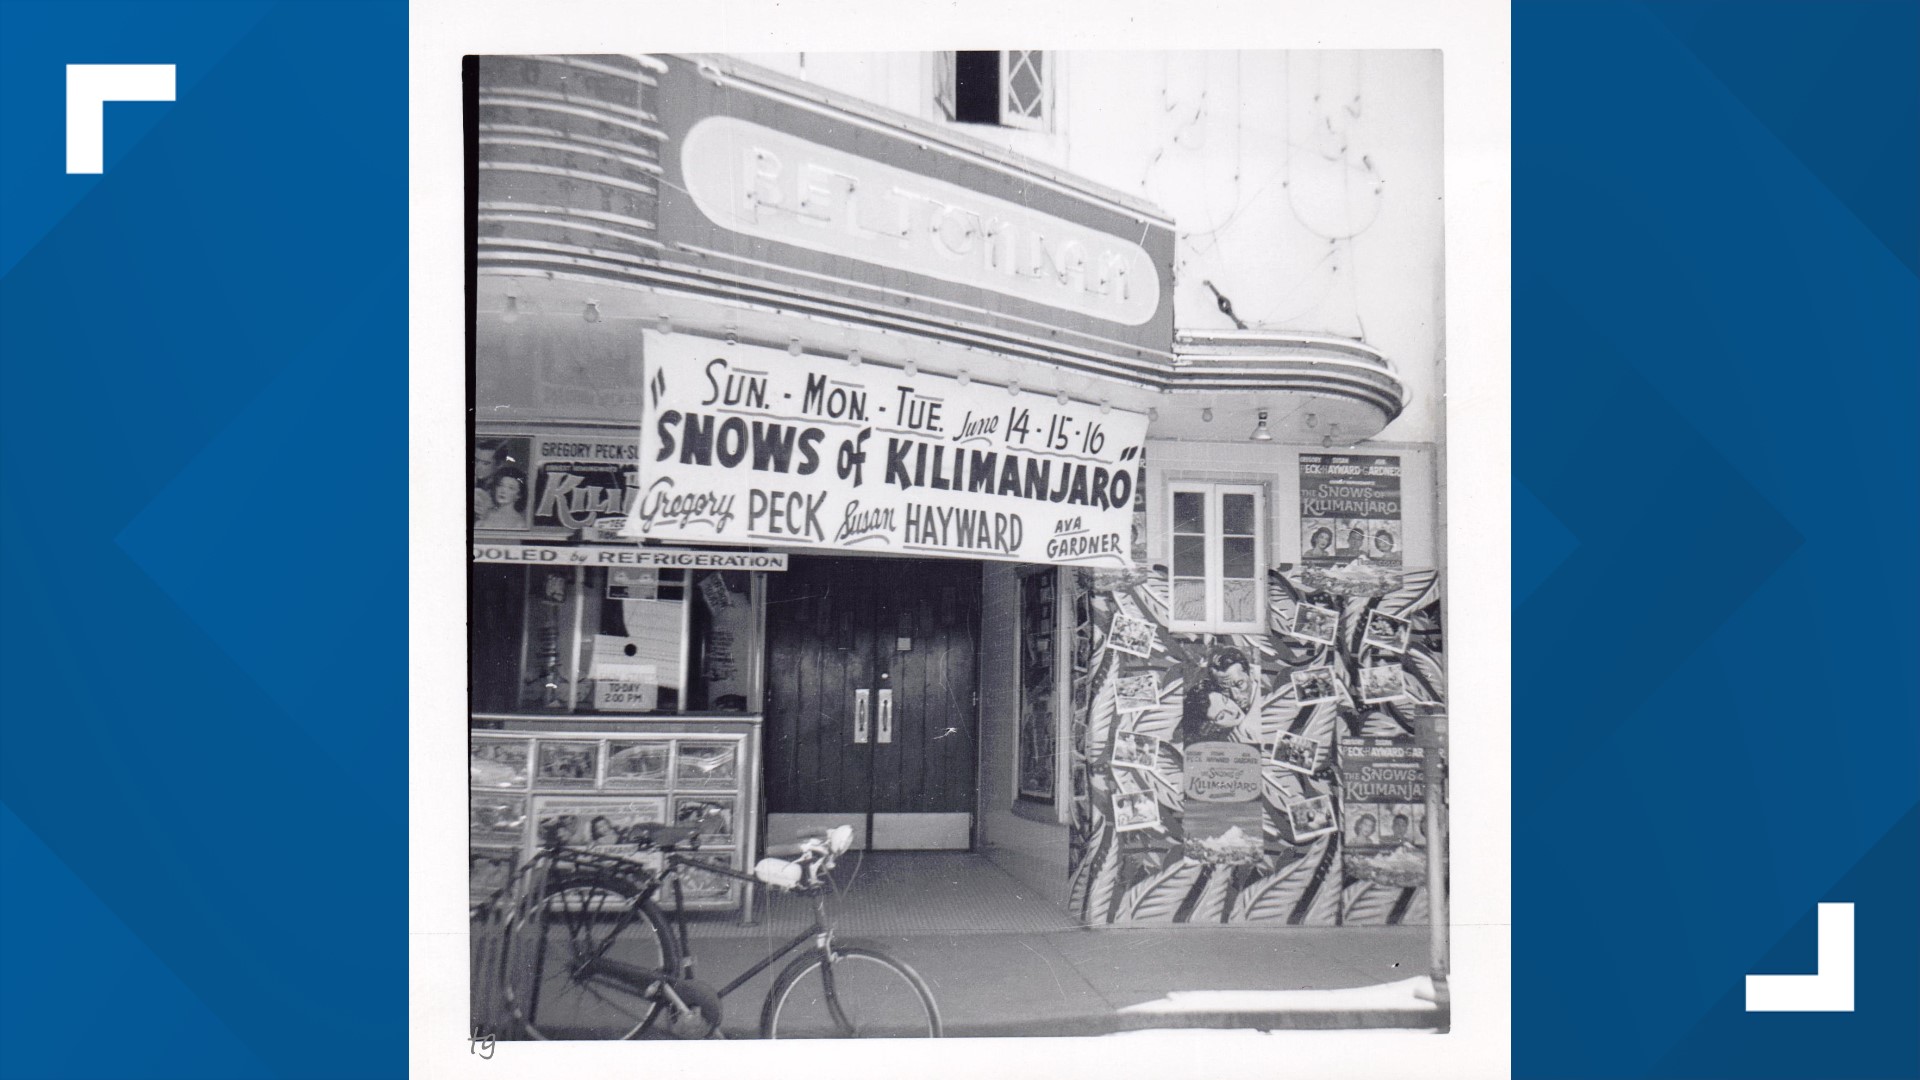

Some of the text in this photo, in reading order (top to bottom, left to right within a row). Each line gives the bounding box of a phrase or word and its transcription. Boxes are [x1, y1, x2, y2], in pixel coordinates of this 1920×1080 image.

[802, 372, 869, 422] MON.
[897, 385, 944, 433] TUE.
[952, 410, 999, 442] June
[836, 427, 871, 488] of
[640, 475, 1023, 555] Gregory PECK Susan HAYWARD
[1054, 516, 1082, 534] AVA
[599, 552, 784, 569] REFRIGERATION
[1047, 533, 1124, 559] GARDNER
